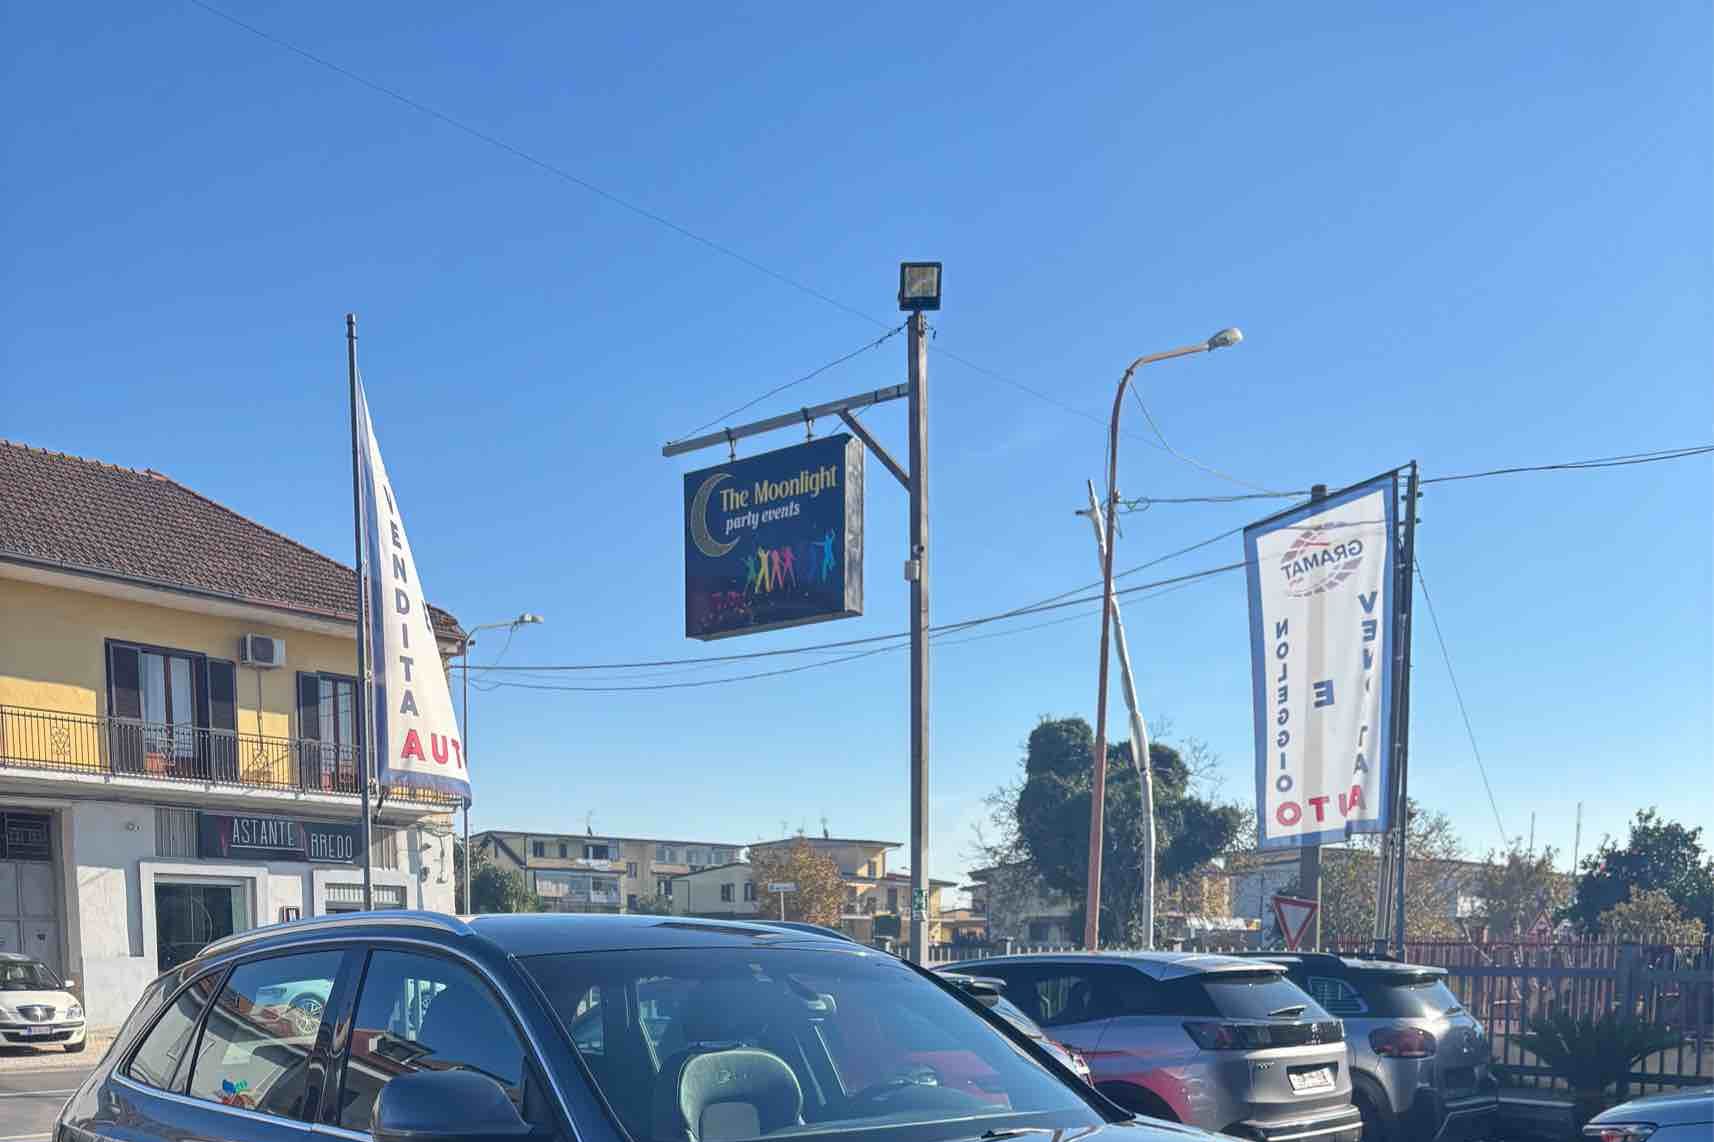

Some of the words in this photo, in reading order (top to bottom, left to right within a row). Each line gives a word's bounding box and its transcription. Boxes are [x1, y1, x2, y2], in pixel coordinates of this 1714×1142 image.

[720, 488, 750, 513] The
[754, 464, 838, 505] Moonlight
[725, 510, 760, 536] party
[762, 501, 800, 523] events
